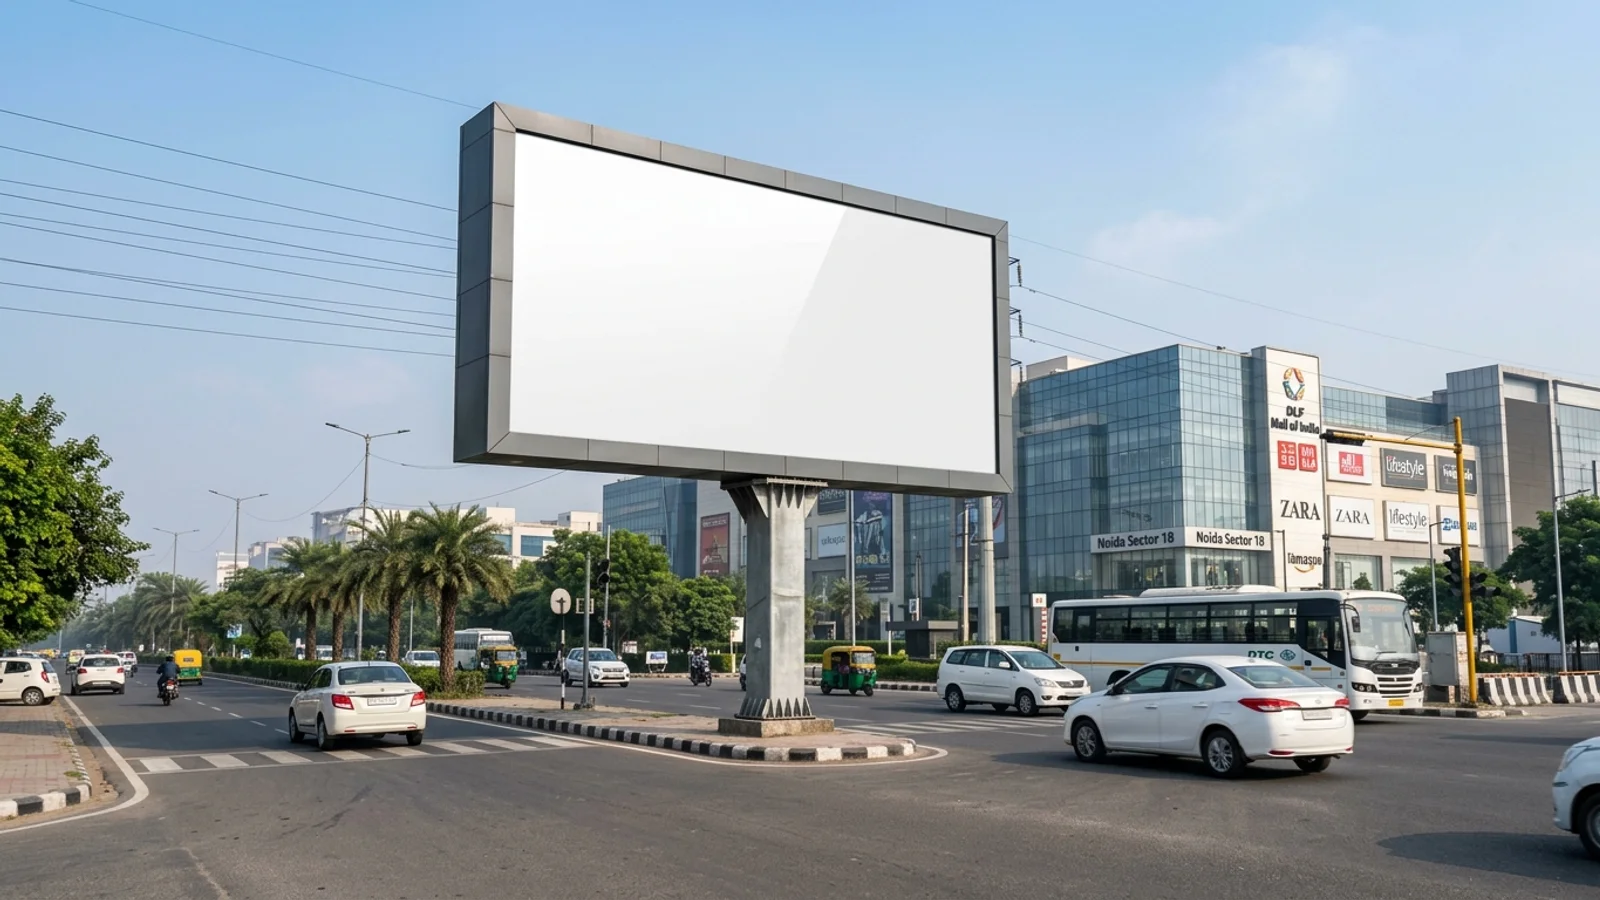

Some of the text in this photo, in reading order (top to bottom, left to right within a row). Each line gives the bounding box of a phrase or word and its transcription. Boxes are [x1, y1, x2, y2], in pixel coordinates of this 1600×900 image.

[1286, 405, 1305, 418] DLF
[1280, 499, 1321, 520] ZARA
[1335, 508, 1370, 525] ZARA
[1097, 531, 1175, 549] Noida Sector 18
[1196, 531, 1265, 546] Noida Sector 18
[1248, 650, 1274, 660] DTC
